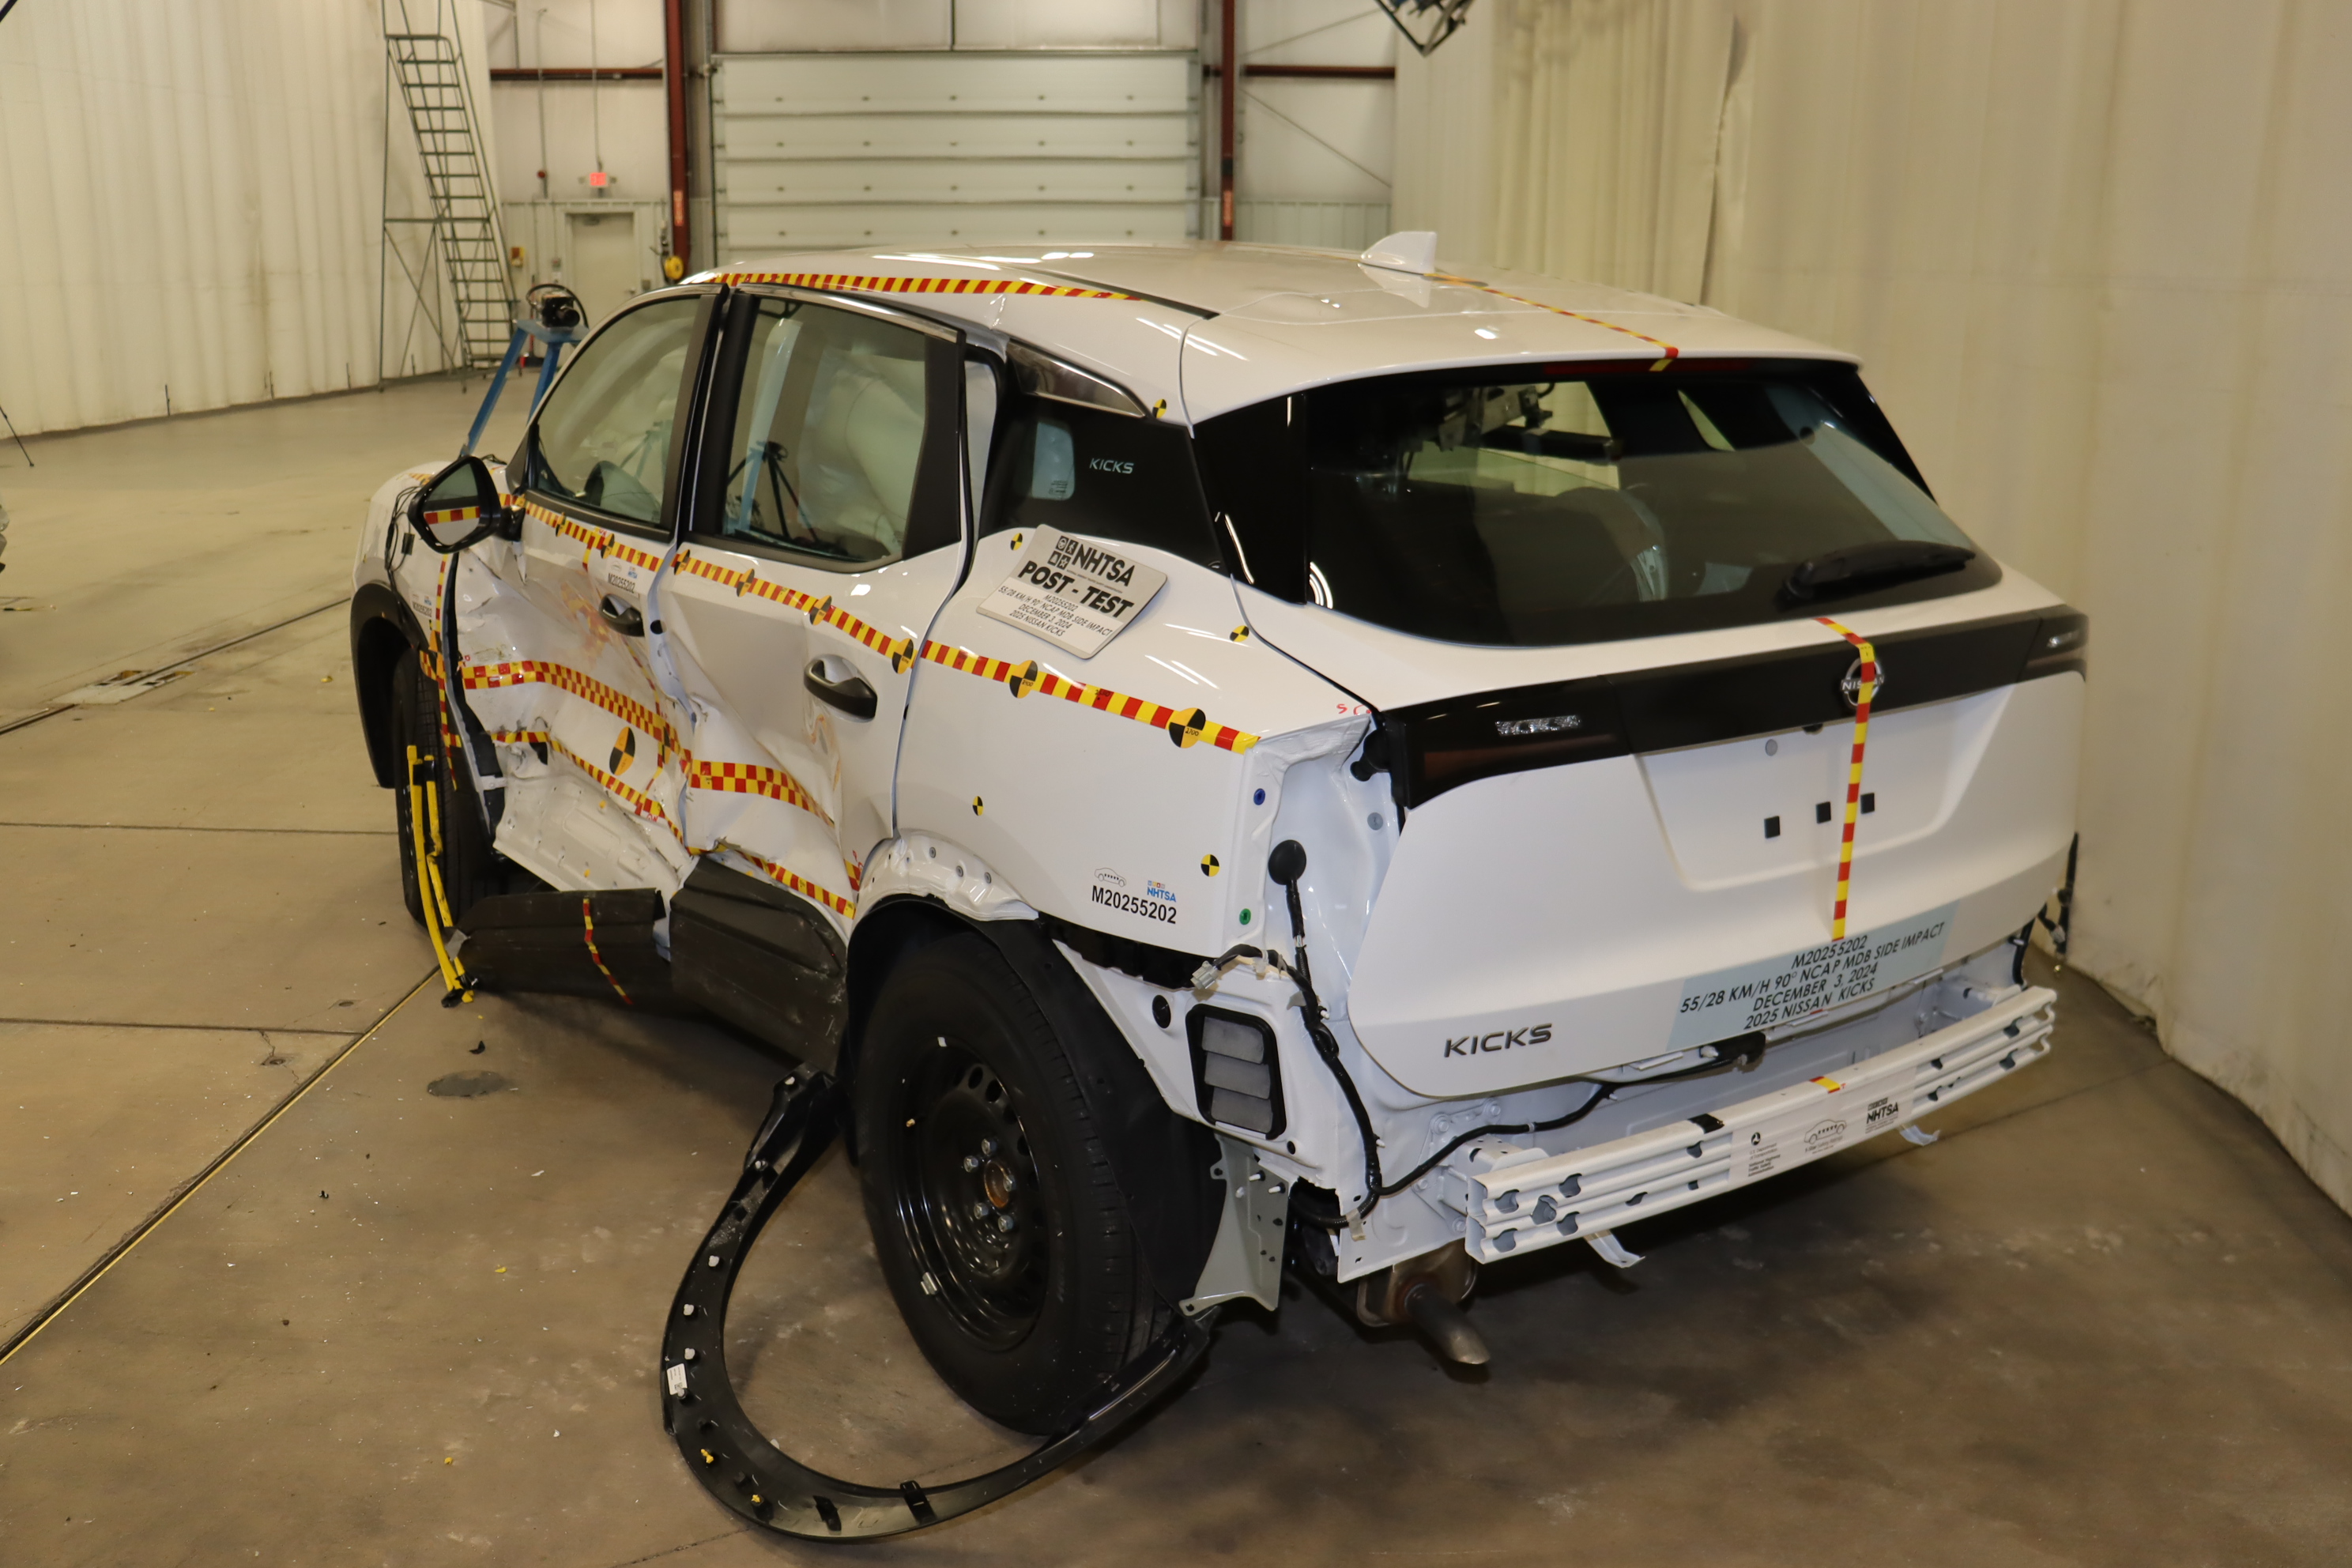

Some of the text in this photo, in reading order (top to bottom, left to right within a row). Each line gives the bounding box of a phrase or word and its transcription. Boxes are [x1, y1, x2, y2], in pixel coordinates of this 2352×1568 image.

[1089, 458, 1134, 474] KICKS
[1072, 544, 1136, 586] NHTSA
[1018, 560, 1075, 594] POST
[1080, 586, 1135, 619] TEST
[1043, 594, 1079, 612] M20255202
[998, 586, 1016, 597] 55/28
[1015, 591, 1031, 603] KM/H
[1040, 602, 1060, 614] NCAP
[1058, 611, 1074, 620] MDB
[1072, 616, 1088, 627] SIDE
[1086, 621, 1113, 636] IMPACT
[1009, 609, 1065, 637] 2025 NISSAN KICKS
[1018, 603, 1051, 620] DECEMBER
[1055, 618, 1073, 629] 2024
[1091, 884, 1177, 924] M20255202
[1147, 887, 1177, 903] NHTSA
[1680, 989, 1725, 1013] 55/28
[1728, 978, 1770, 1001] KM/H
[1800, 959, 1841, 983] NCAP
[1842, 950, 1871, 971] MDB
[1874, 939, 1900, 959] SIDE
[1901, 922, 1945, 950] IMPACT
[1791, 935, 1868, 970] M20255202
[1743, 978, 1875, 1030] 2025 NISSAN KICKS
[1753, 961, 1879, 1012] DECEMBER 3, 2024
[1444, 1023, 1553, 1057] KICKS
[1867, 1102, 1898, 1124] NHTSA
